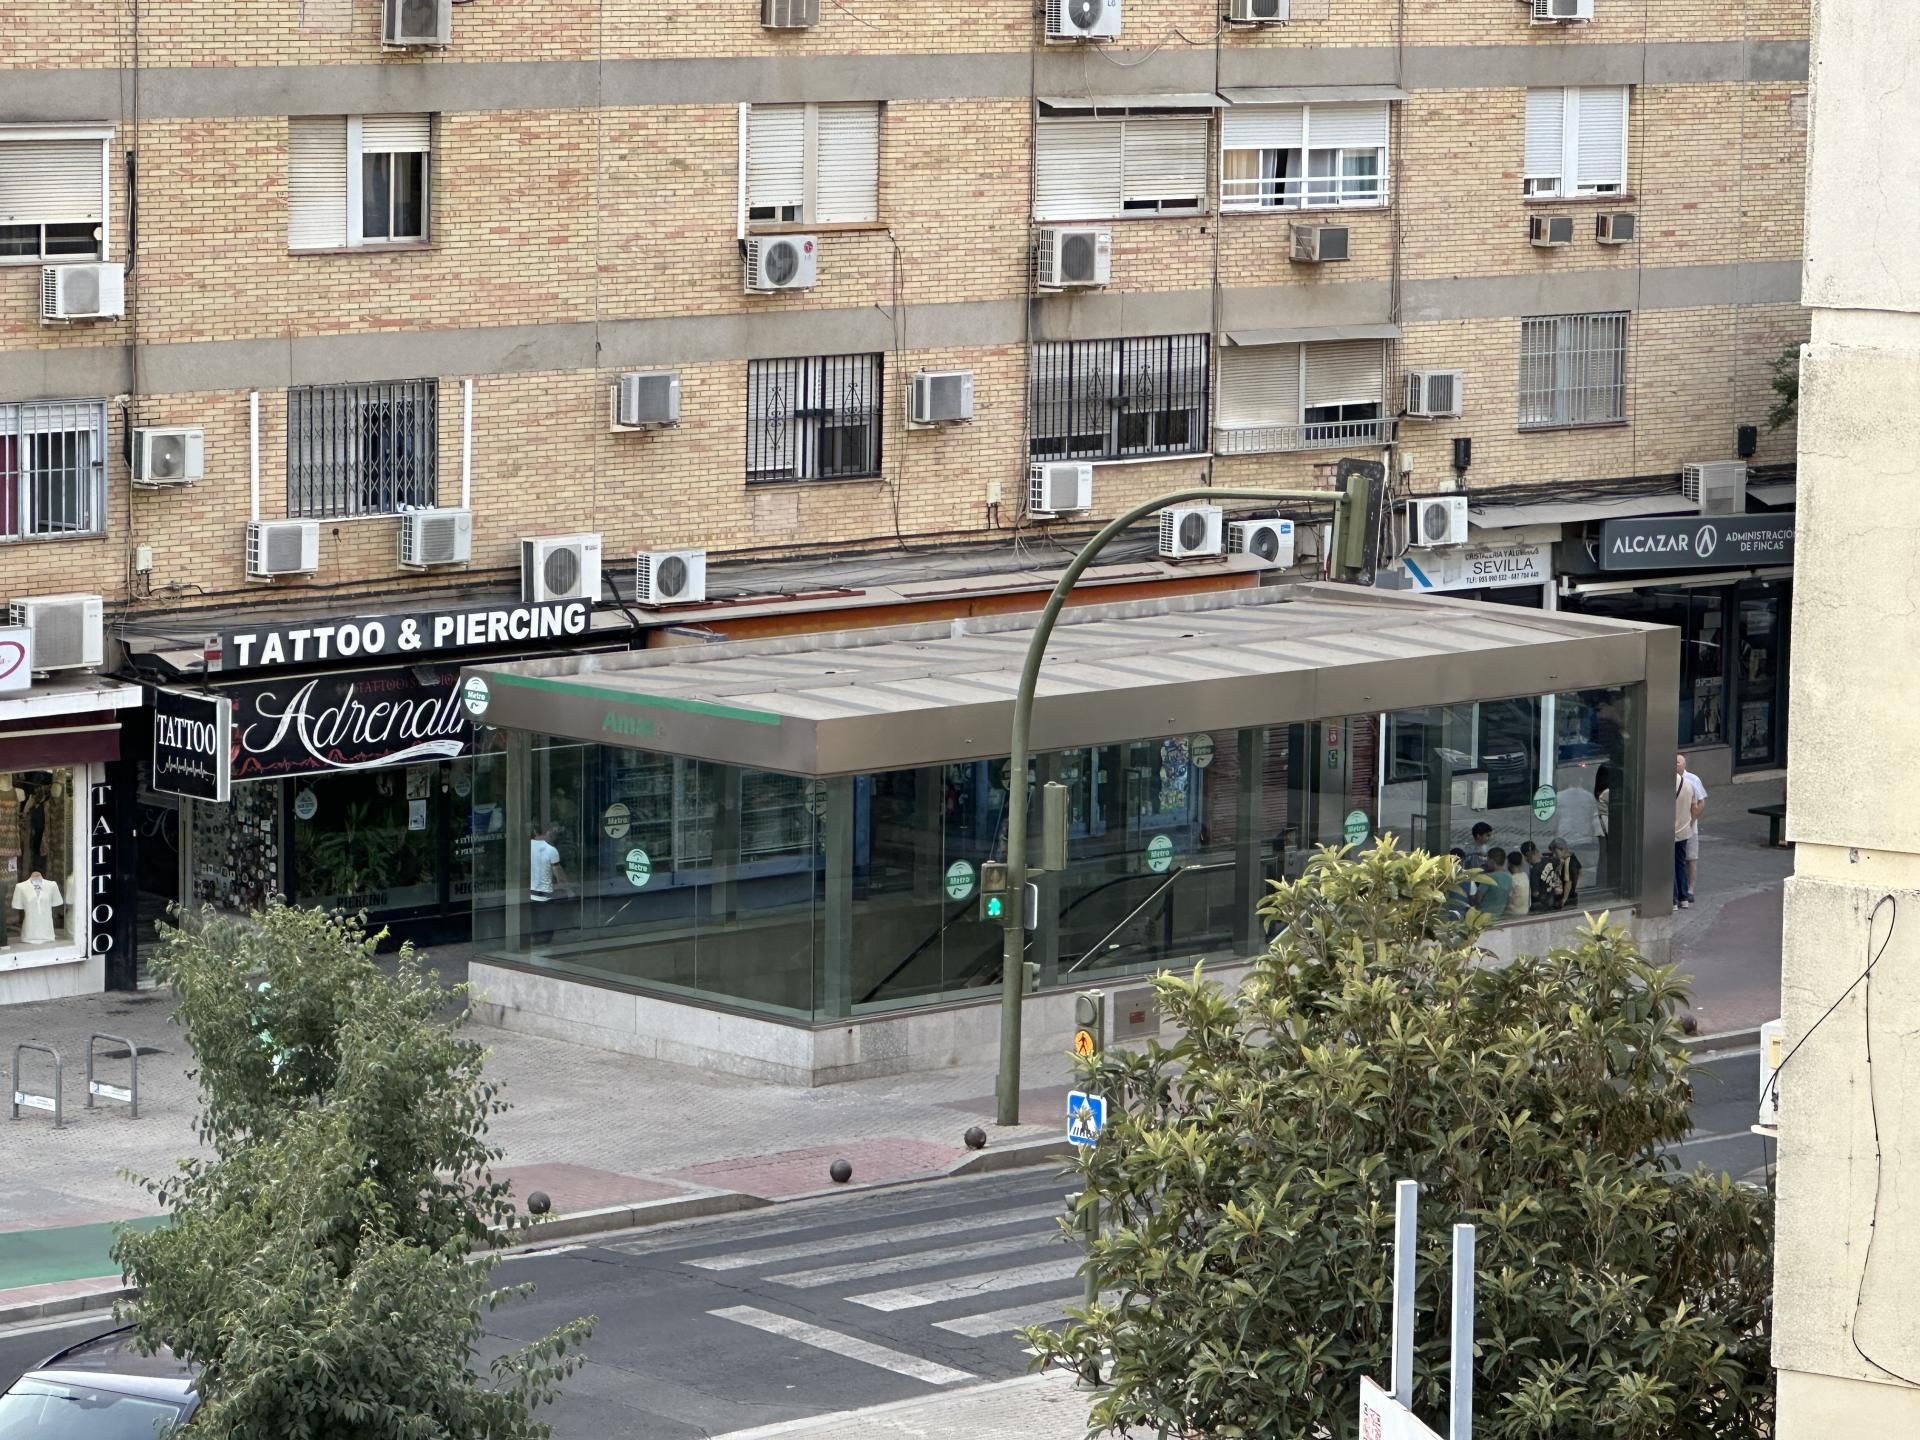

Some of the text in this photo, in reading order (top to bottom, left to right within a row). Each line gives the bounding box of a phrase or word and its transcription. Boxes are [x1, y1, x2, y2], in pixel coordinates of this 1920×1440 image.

[1613, 534, 1688, 554] ALCAZAR
[1740, 540, 1784, 551] DE FINCAS
[1473, 558, 1533, 575] SEVILLA
[234, 602, 586, 666] TATTOO & PIERCING
[467, 690, 486, 701] Metro
[156, 713, 217, 756] TATTOO
[1536, 799, 1554, 808] Metro
[607, 817, 629, 825] Metro
[1347, 824, 1366, 834] Metro
[1151, 850, 1170, 859] Metro
[91, 785, 114, 954] TATTOO
[628, 861, 648, 872] Metro
[950, 876, 970, 885] Metro
